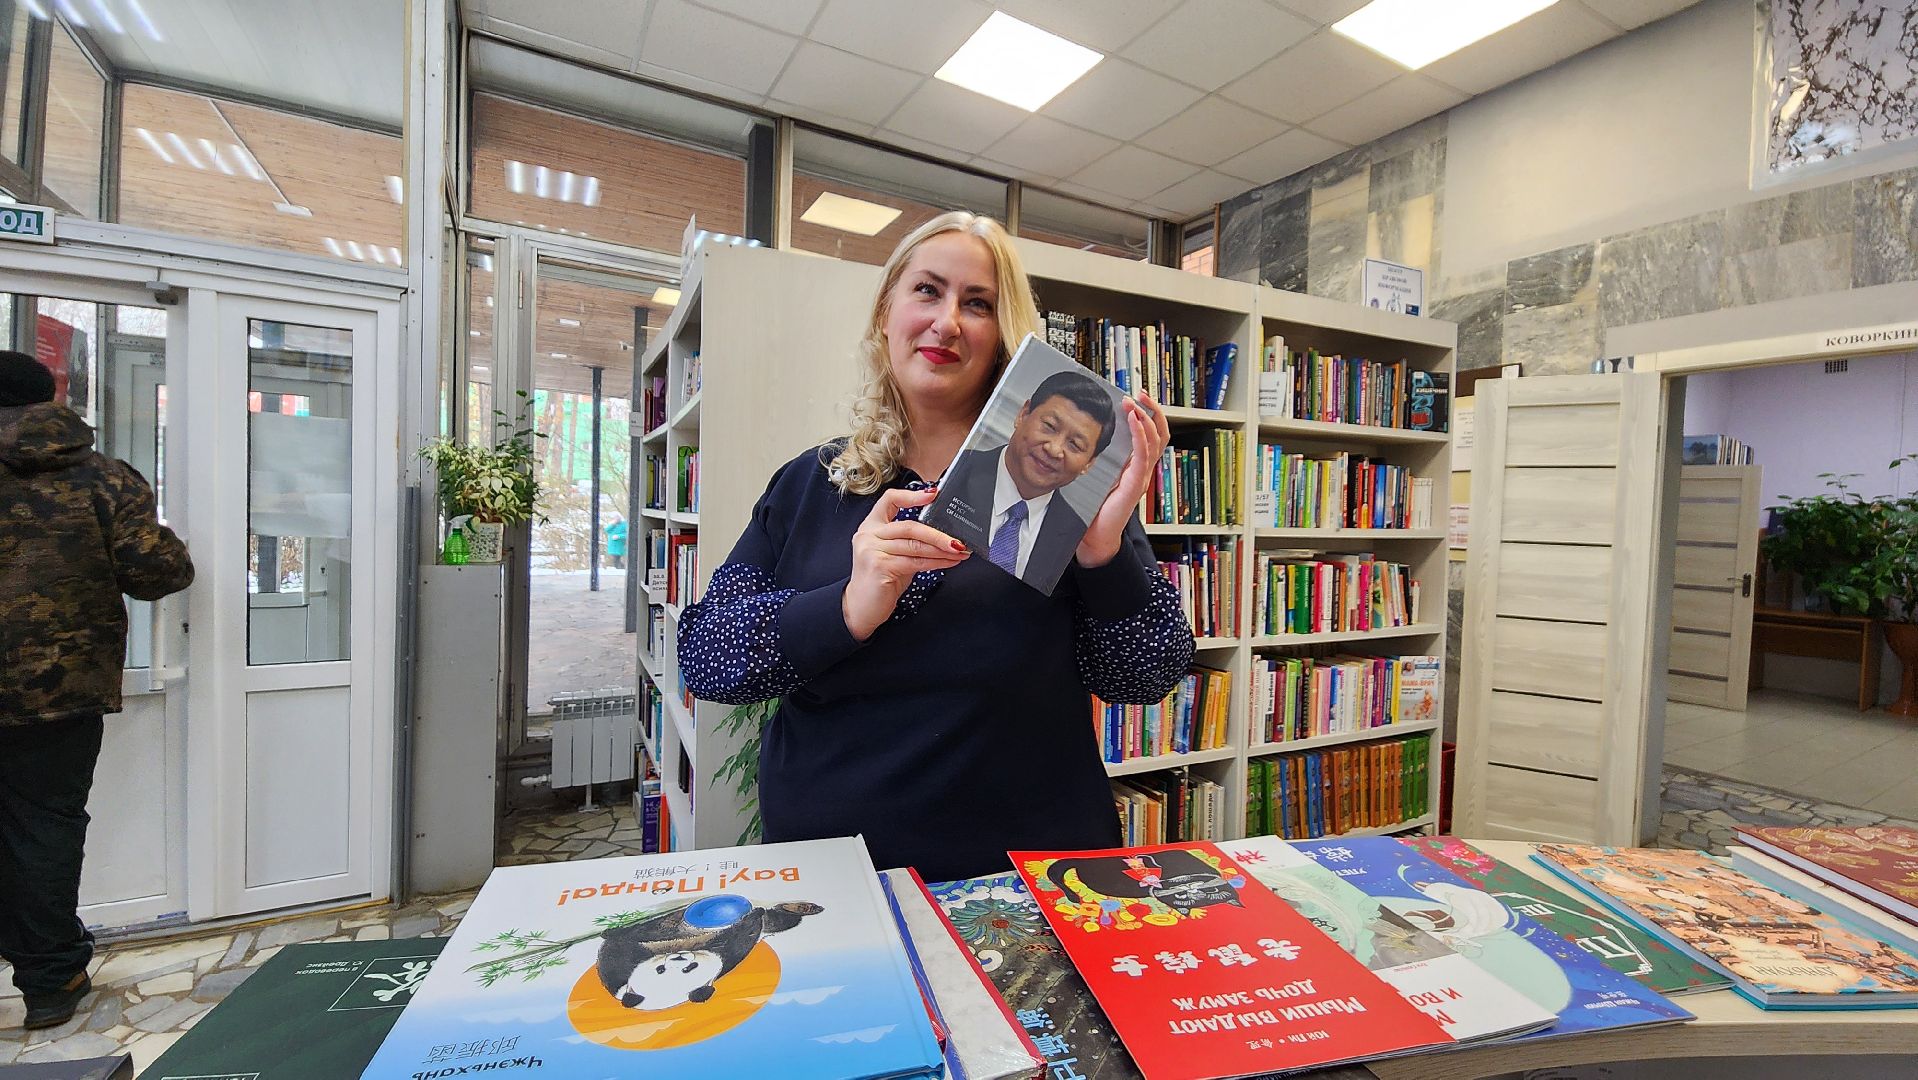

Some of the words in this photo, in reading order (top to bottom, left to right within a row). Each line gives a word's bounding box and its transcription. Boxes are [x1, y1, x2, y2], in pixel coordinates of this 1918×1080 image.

[1233, 849, 1268, 865] 神
[557, 876, 704, 906] Панда!
[719, 867, 800, 890] Вау!
[1110, 938, 1301, 978] 老鼠嫁女
[1171, 990, 1256, 1011] ЗАМУЖ
[1255, 978, 1317, 1007] ДОЧЬ
[1167, 1008, 1279, 1035] ВЫДАЮТ
